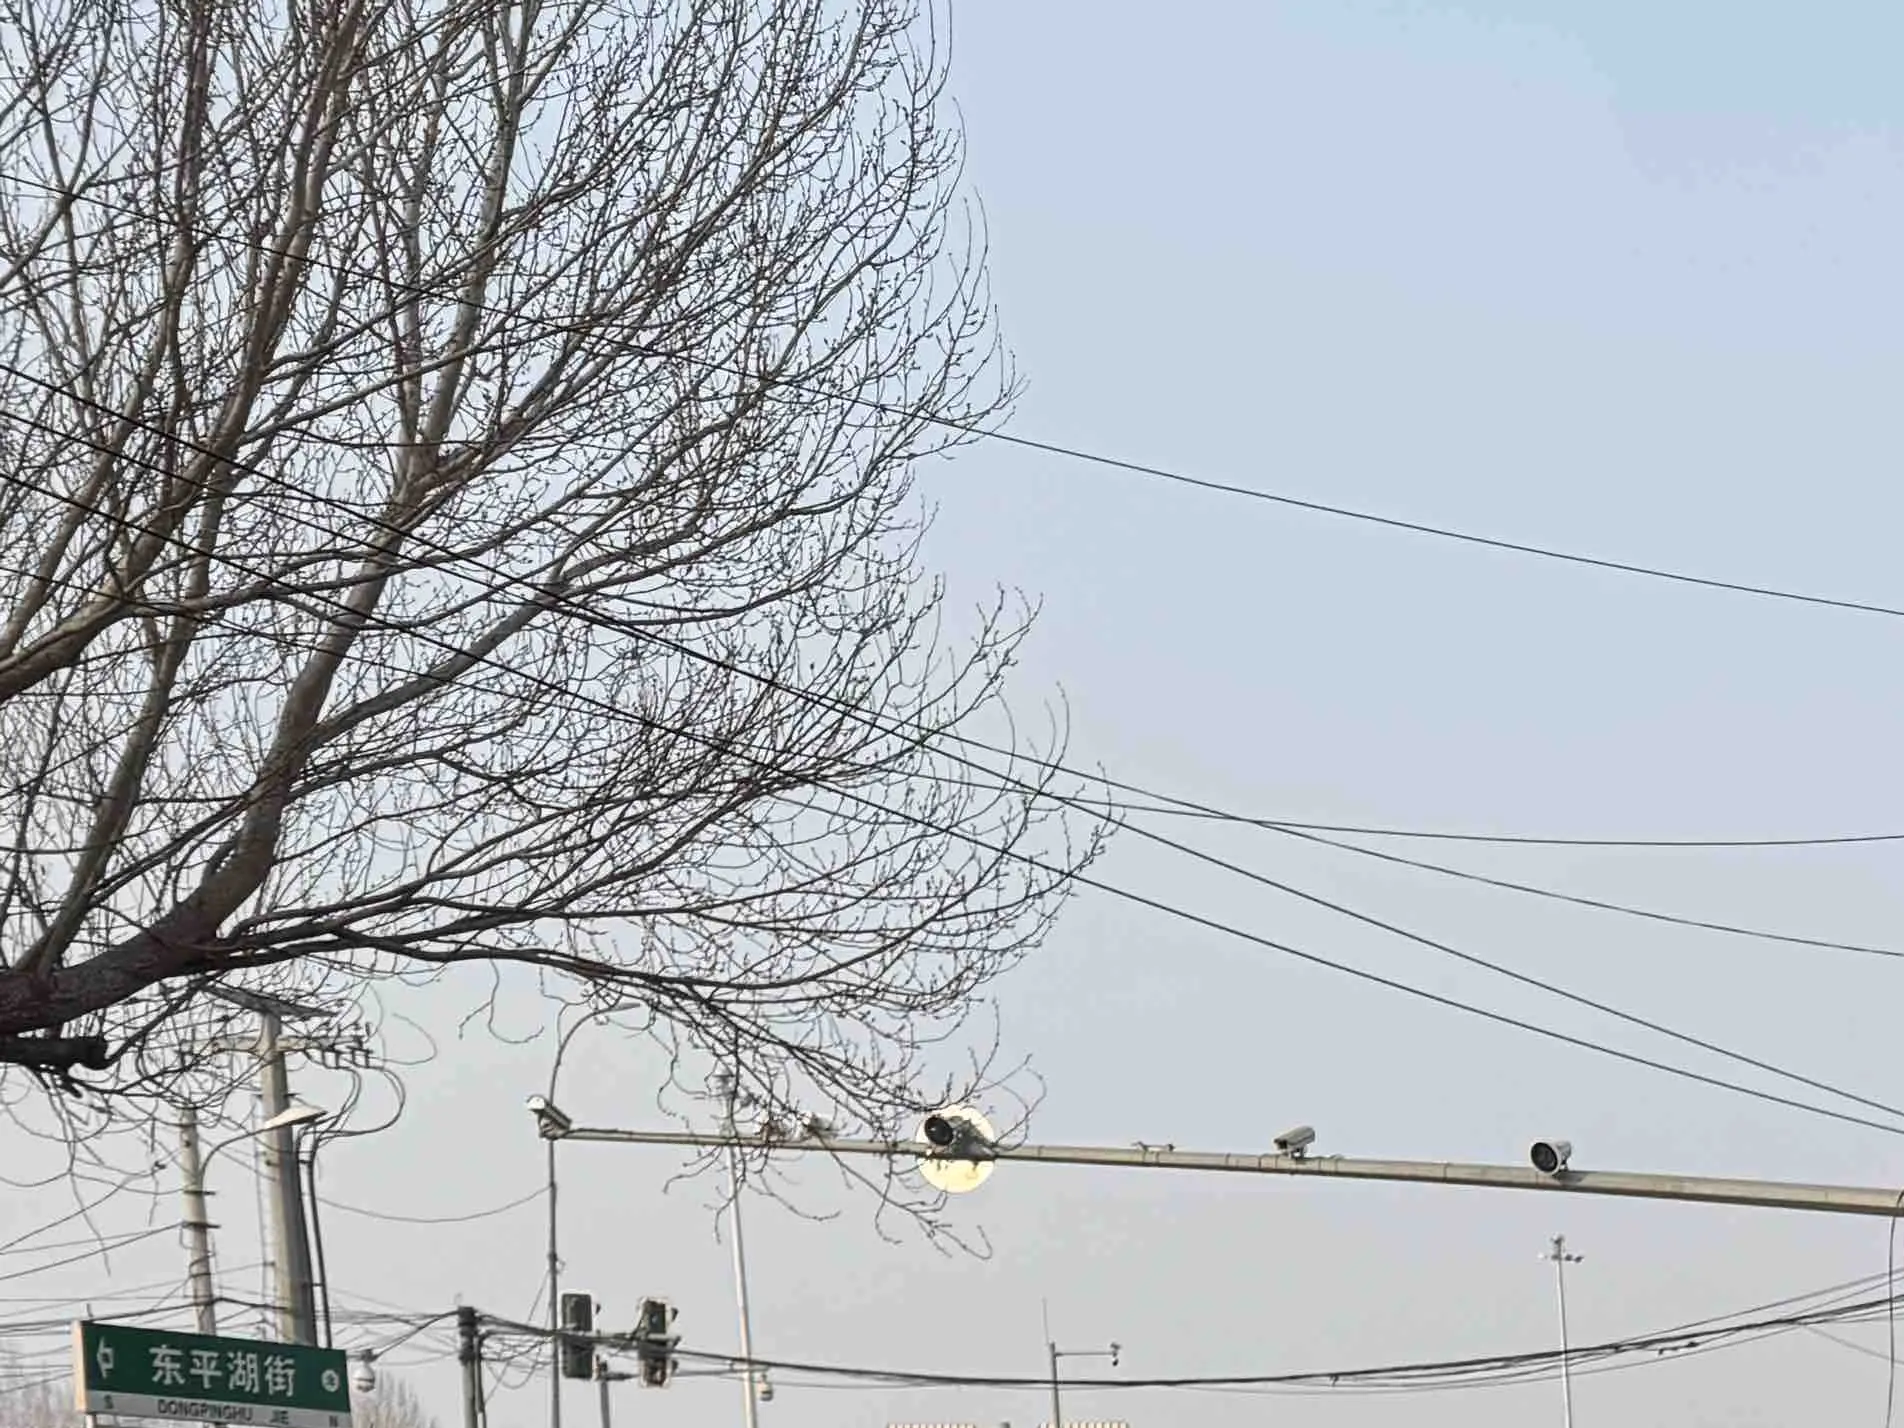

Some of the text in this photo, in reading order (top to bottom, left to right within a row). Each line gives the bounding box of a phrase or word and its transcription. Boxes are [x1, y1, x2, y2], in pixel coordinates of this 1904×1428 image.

[149, 1344, 297, 1398] 东平湖街
[157, 1399, 253, 1422] DONGPINGHU
